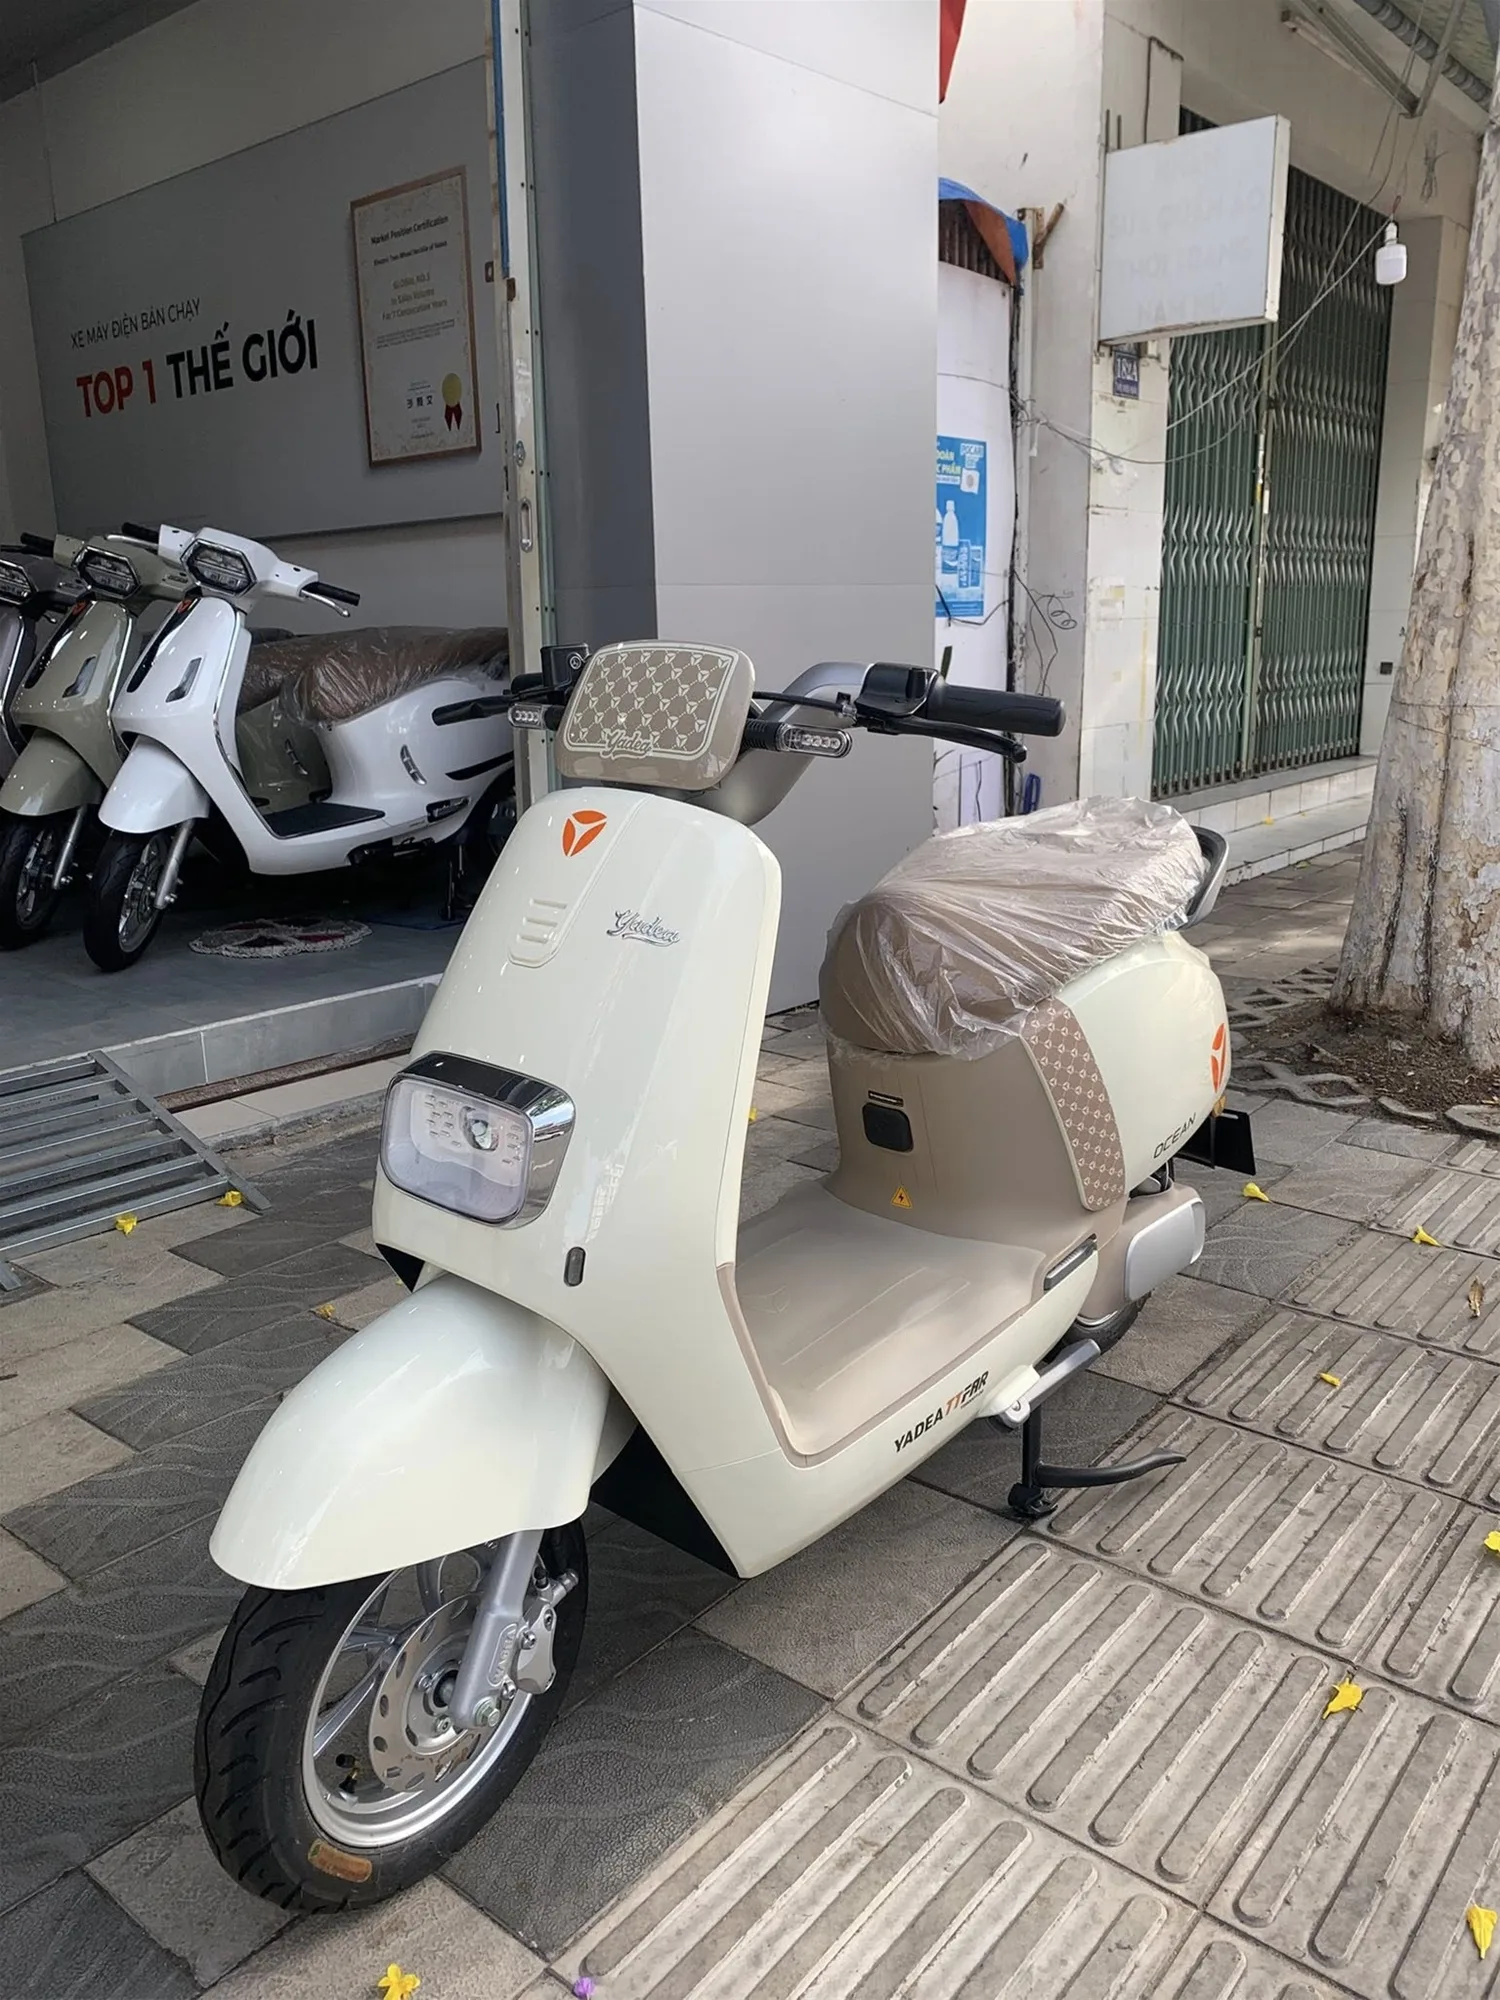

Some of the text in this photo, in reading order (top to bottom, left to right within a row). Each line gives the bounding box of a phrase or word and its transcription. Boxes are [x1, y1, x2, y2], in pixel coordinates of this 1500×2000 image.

[370, 214, 449, 245] Market Position Certification
[70, 296, 201, 349] XE MÁY ĐIỆN BÁN CHẠY
[76, 365, 134, 418] TOP
[141, 358, 157, 405] 1
[166, 322, 234, 399] THẾ
[242, 309, 318, 383] GIỚI
[602, 729, 653, 758] Yadea
[606, 909, 681, 947] Yadea
[1153, 1111, 1197, 1160] OCEAN
[893, 1407, 944, 1454] YADEA
[944, 1370, 990, 1416] TTFAR
